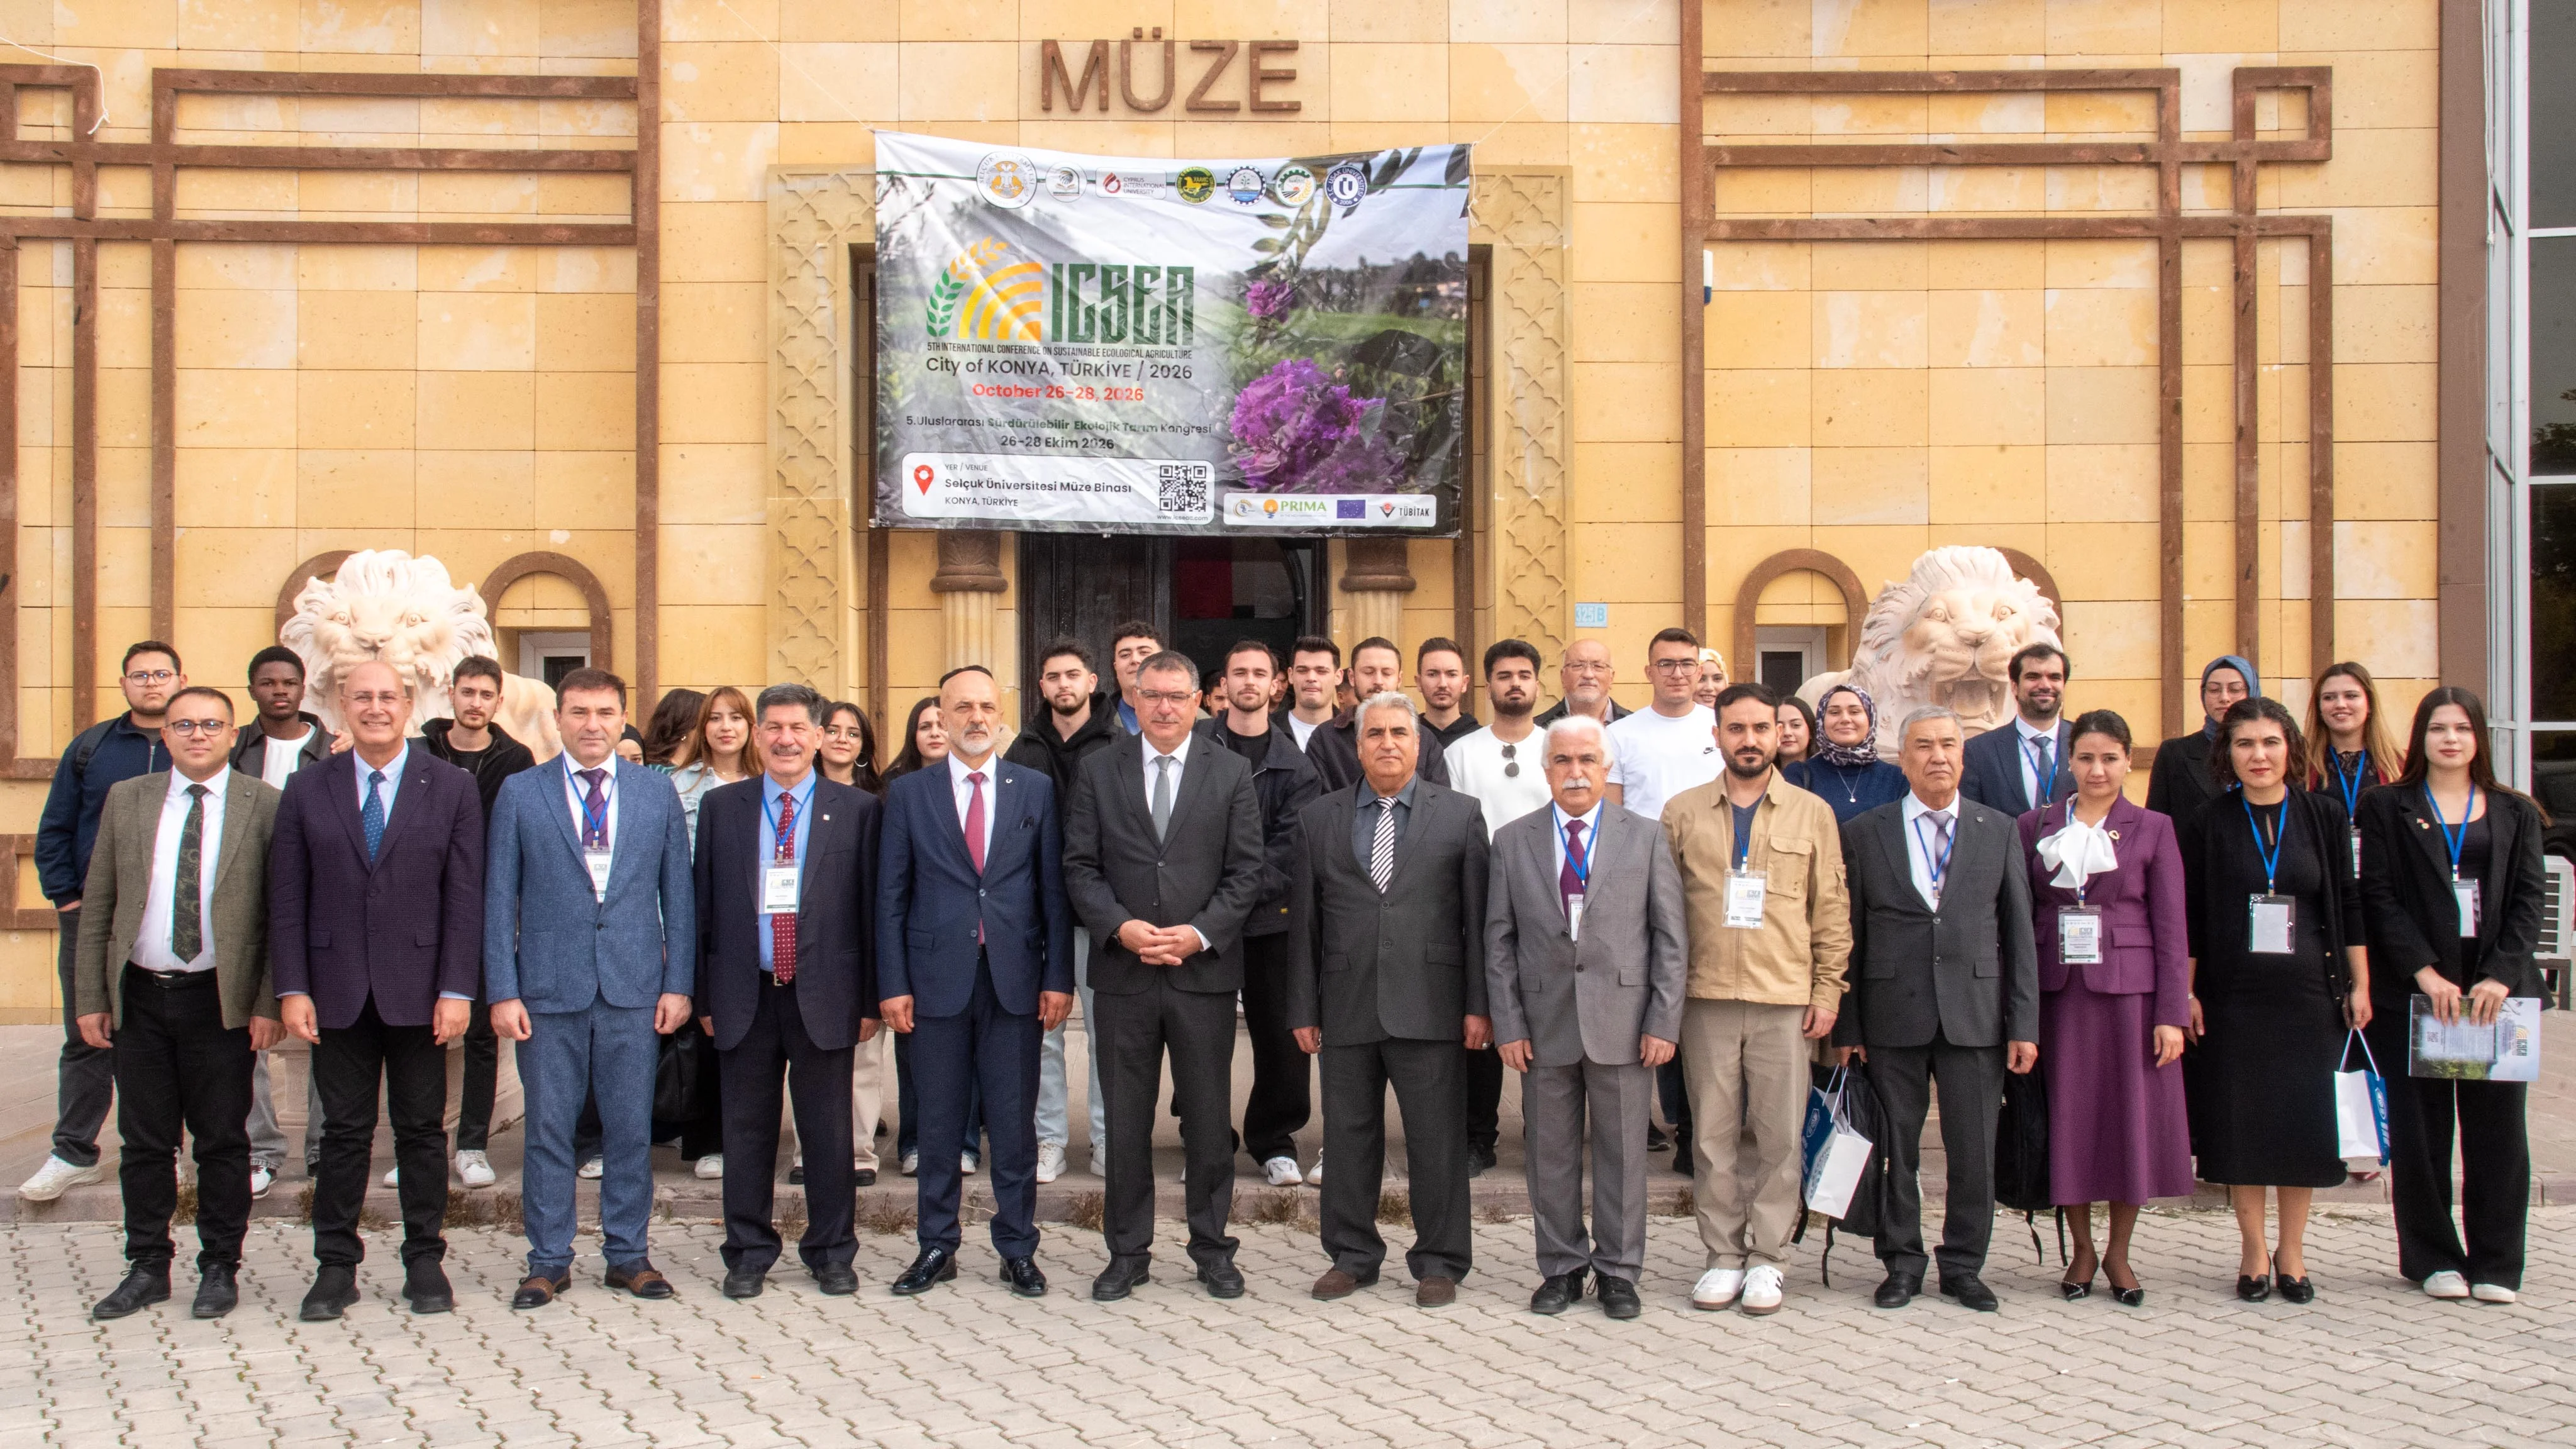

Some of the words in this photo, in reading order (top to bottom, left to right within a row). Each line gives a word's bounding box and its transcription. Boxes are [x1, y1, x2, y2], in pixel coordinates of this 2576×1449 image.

[1041, 27, 1301, 111] MÜZE
[1052, 263, 1194, 345] ICSEA
[928, 342, 940, 352] 5TH
[941, 342, 995, 353] INTERNATIONAL
[997, 345, 1041, 355] CONFERENCE
[1043, 347, 1052, 355] ON
[1053, 347, 1100, 357] SUSTAINABLE
[1102, 348, 1144, 358] ECOLOGICAL
[1145, 349, 1192, 359] AGRICULTURE
[926, 356, 960, 377] City
[965, 358, 984, 373] of
[988, 359, 1055, 377] KONYA,
[1059, 359, 1131, 378] TÜRKİYE
[1136, 360, 1145, 381] /
[1150, 364, 1192, 379] 2026
[972, 383, 1041, 399] October
[1045, 384, 1100, 402] 26-28,
[1104, 386, 1145, 401] 2026
[987, 418, 1070, 430] Sürdürülebilir
[1074, 420, 1120, 434] Ekolojik
[1123, 422, 1158, 433] Tarım
[1160, 423, 1212, 436] Kongresi
[1001, 435, 1041, 448] 26-28
[1045, 436, 1078, 448] Ekim
[1081, 438, 1114, 449] 2026
[960, 463, 963, 471] /
[945, 479, 984, 491] Selçuk
[986, 478, 1057, 491] Üniversitesi
[1060, 482, 1091, 492] Müze
[1094, 482, 1131, 492] Binası
[945, 497, 980, 506] KONYA,
[982, 496, 1019, 507] TÜRKİYE
[1280, 501, 1327, 512] PRIMA
[1399, 506, 1430, 516] TÜBİTAK
